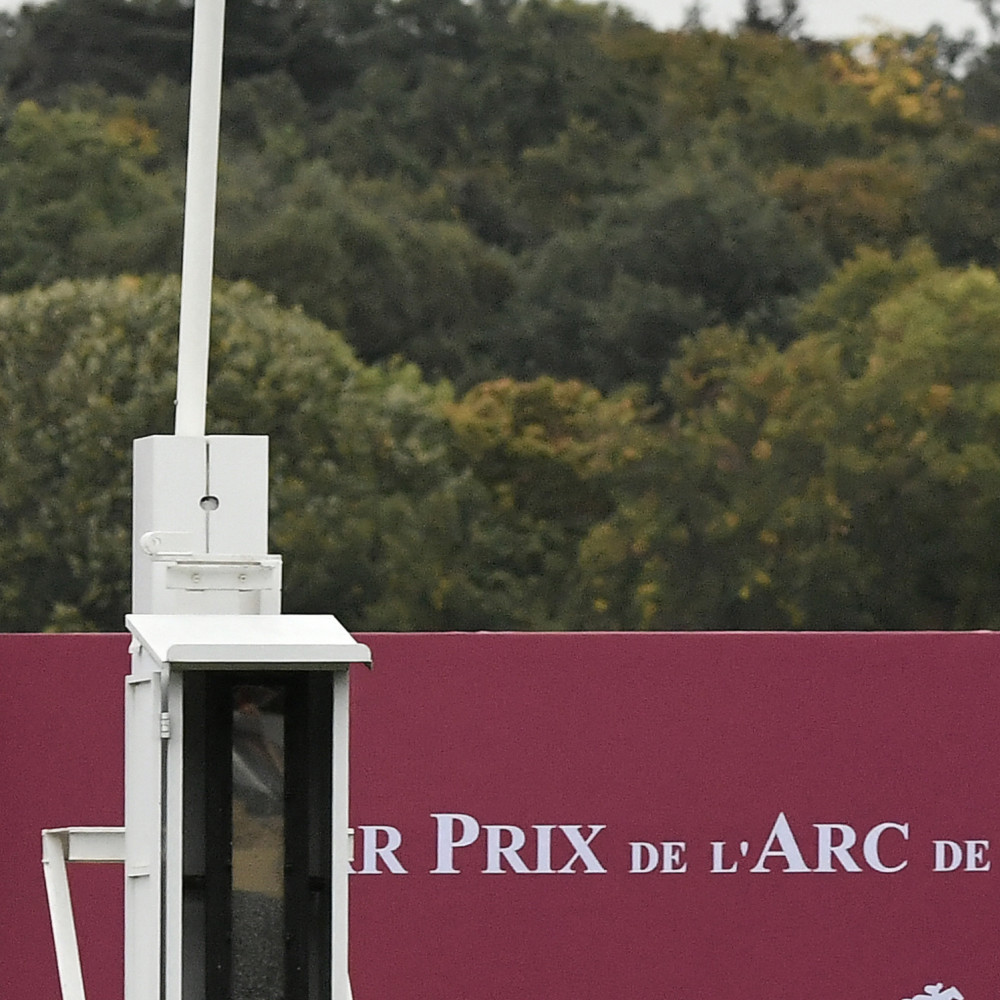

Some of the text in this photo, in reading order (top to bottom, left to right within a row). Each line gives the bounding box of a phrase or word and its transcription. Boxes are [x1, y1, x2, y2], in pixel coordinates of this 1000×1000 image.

[430, 814, 607, 873] PRIX
[629, 842, 686, 873] DE
[711, 812, 908, 872] L'ARC
[933, 841, 990, 871] DE
